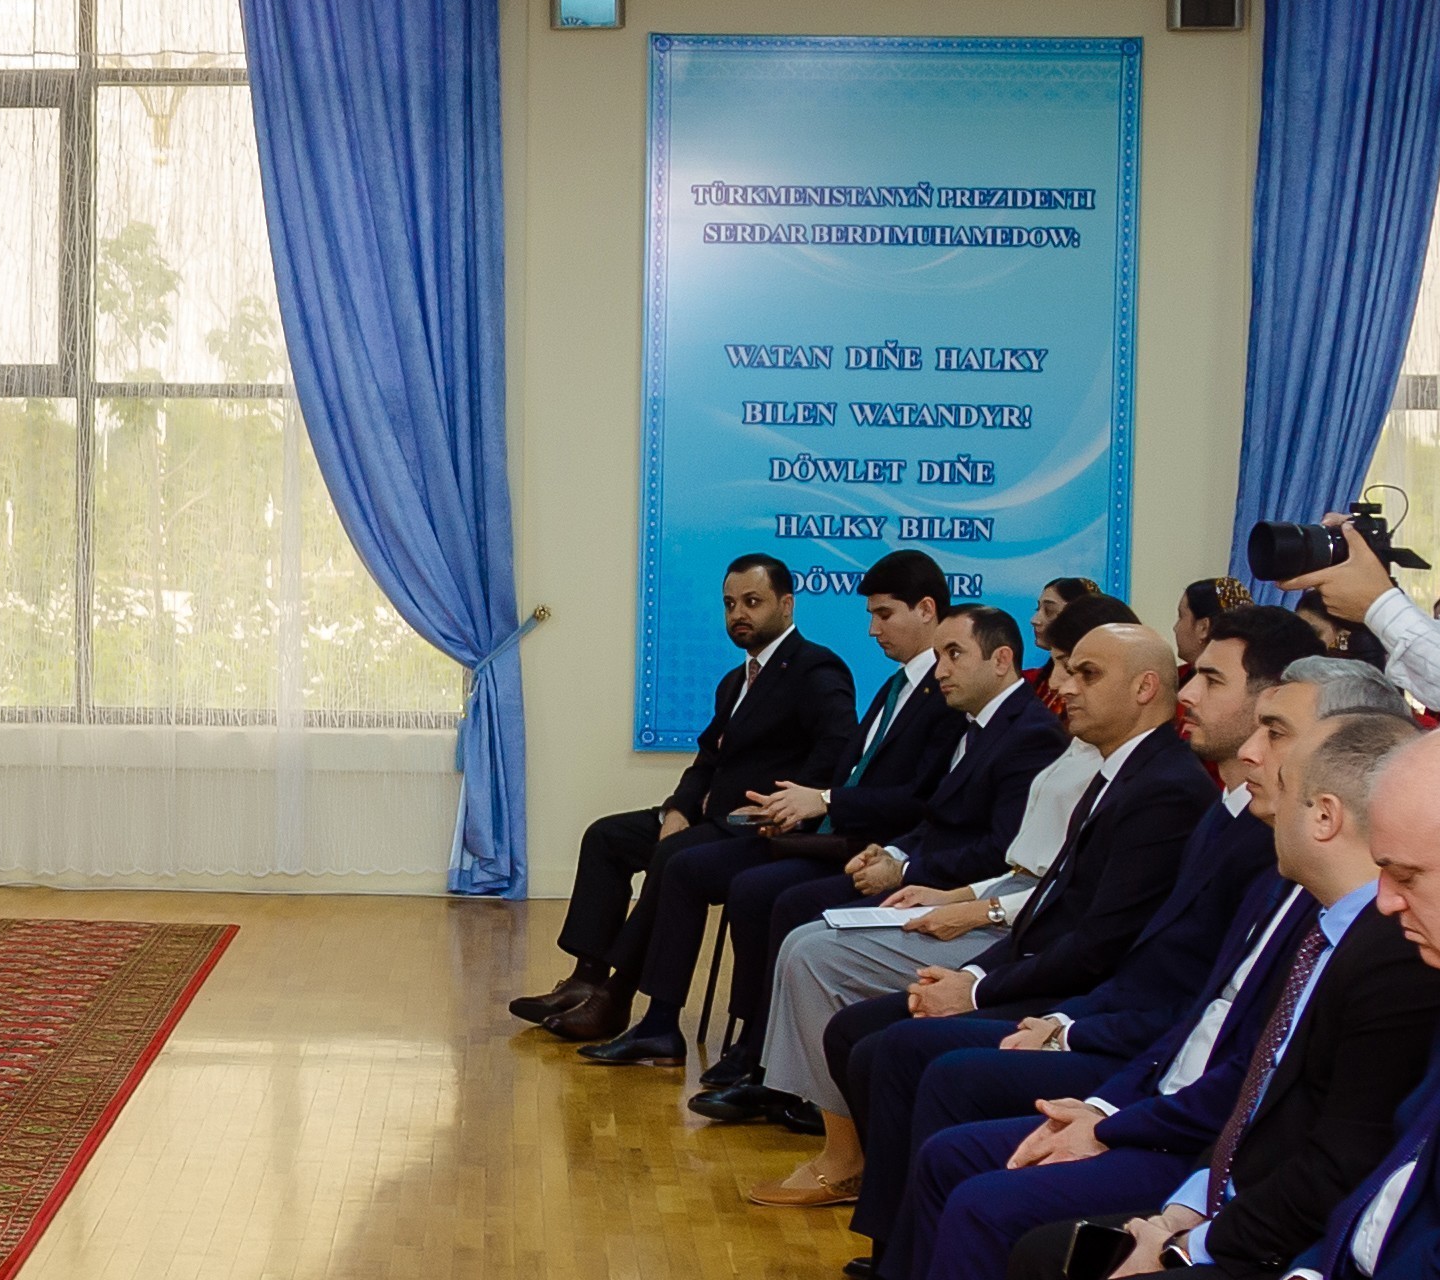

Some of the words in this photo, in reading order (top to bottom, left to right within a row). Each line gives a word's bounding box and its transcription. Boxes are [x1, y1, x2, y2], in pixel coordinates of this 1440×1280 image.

[692, 181, 933, 208] TÜRKMENISTANYŇ
[937, 187, 1096, 210] PREZIDENTI
[703, 223, 808, 245] SERDAR
[812, 225, 1081, 248] BERDIMUHAMEDOW:
[725, 344, 833, 369] WATAN
[846, 340, 922, 370] DIŇE
[936, 348, 1048, 372] HALKY
[743, 401, 837, 426] BILEN
[850, 402, 1032, 428] WATANDYR!
[770, 453, 906, 483] DÖWLET
[919, 454, 994, 485] DIŇE
[776, 515, 886, 540] HALKY
[898, 516, 994, 541] BILEN
